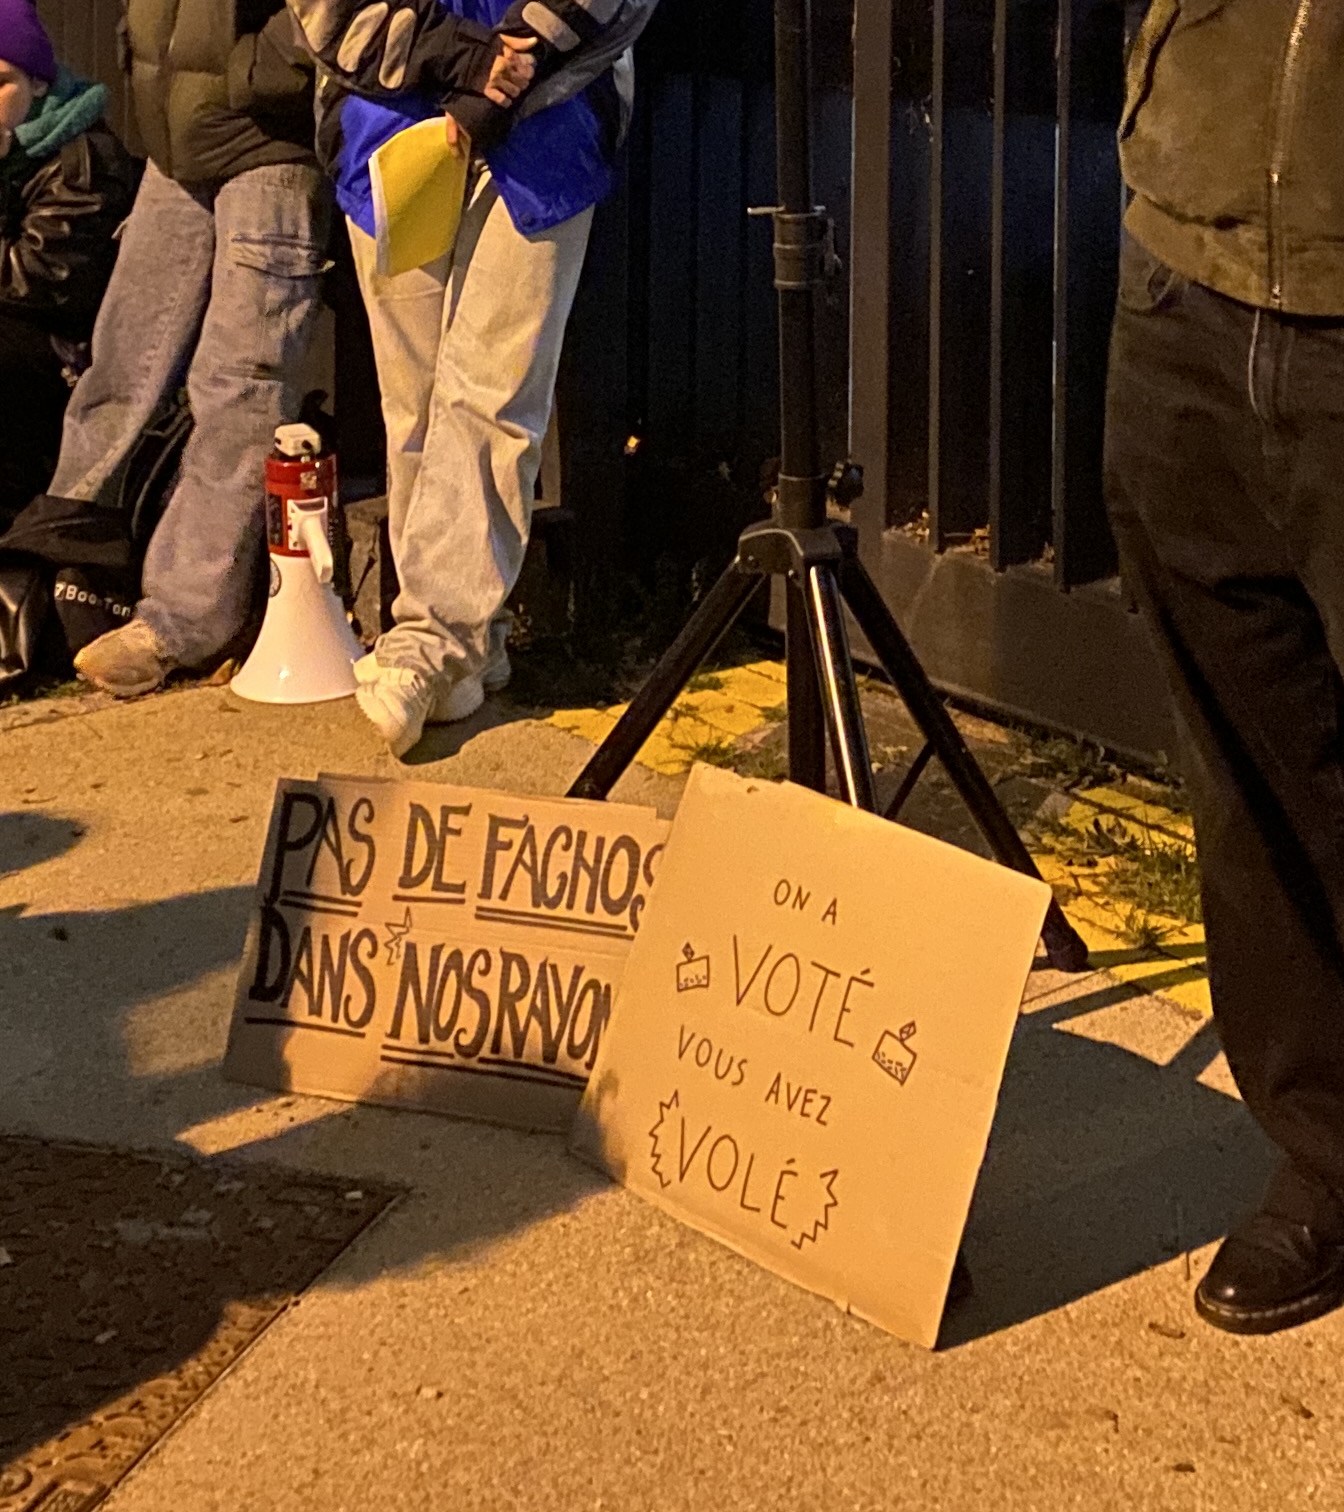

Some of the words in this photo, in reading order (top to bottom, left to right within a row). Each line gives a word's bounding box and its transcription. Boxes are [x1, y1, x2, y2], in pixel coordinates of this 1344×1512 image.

[266, 791, 376, 905] PAS
[397, 802, 473, 894] DE
[773, 879, 811, 911] ON
[820, 897, 838, 925] A
[247, 899, 379, 1029] DANS
[385, 941, 492, 1060] NOS
[732, 933, 875, 1048] VOTÉ
[677, 1023, 749, 1086] VOUS
[764, 1071, 832, 1126] AVEZ
[678, 1116, 799, 1230] VOLÉ
